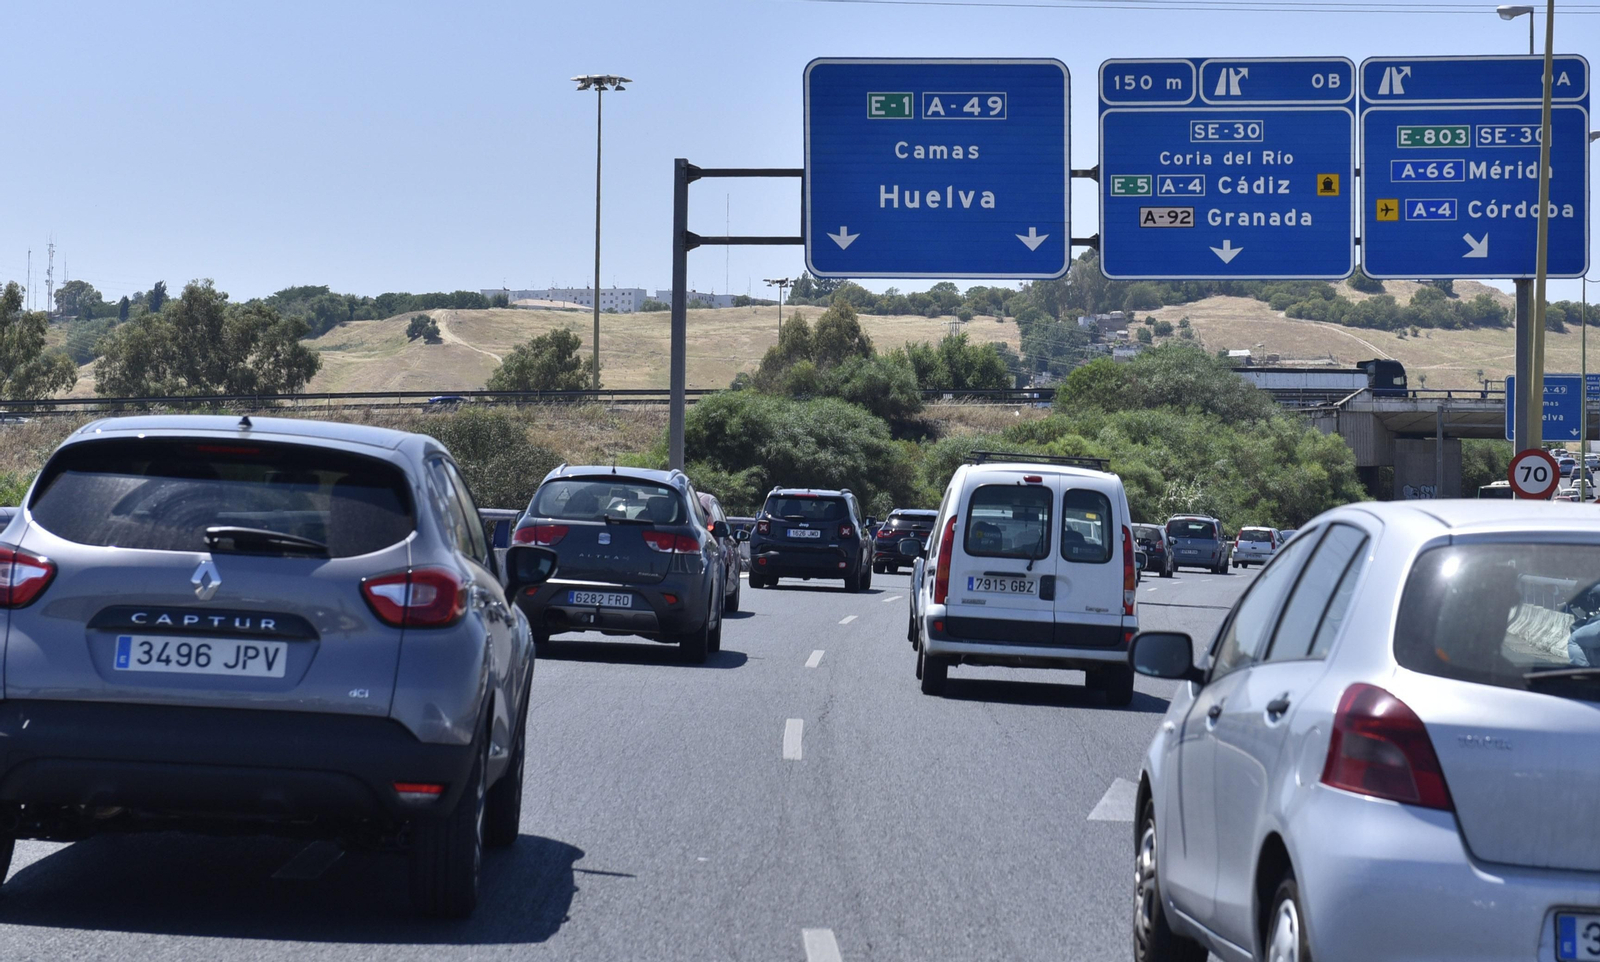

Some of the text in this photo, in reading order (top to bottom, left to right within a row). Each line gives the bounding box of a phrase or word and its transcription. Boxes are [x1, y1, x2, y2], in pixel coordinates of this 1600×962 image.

[1114, 75, 1182, 90] 150 m
[1311, 73, 1341, 89] 0B
[871, 96, 1003, 116] E-1 A-49
[1194, 124, 1260, 139] SE-30
[1400, 129, 1467, 145] E-803
[895, 141, 979, 160] Camas
[1159, 150, 1294, 166] Coria del Río
[1401, 163, 1456, 179] A-66
[1114, 176, 1290, 194] E-5 A-4 Cádiz
[880, 185, 996, 209] Huelva
[1412, 199, 1574, 218] A-4 Córdoba
[1143, 208, 1312, 226] A-92 Granada
[1542, 386, 1567, 394] A-49
[1541, 413, 1564, 421] elva
[1520, 466, 1548, 483] 70
[975, 578, 1034, 593] 7915 GBZ
[575, 592, 630, 606] 6282 FRD
[131, 612, 276, 630] CAPTUR
[136, 640, 280, 671] 3496 JPV
